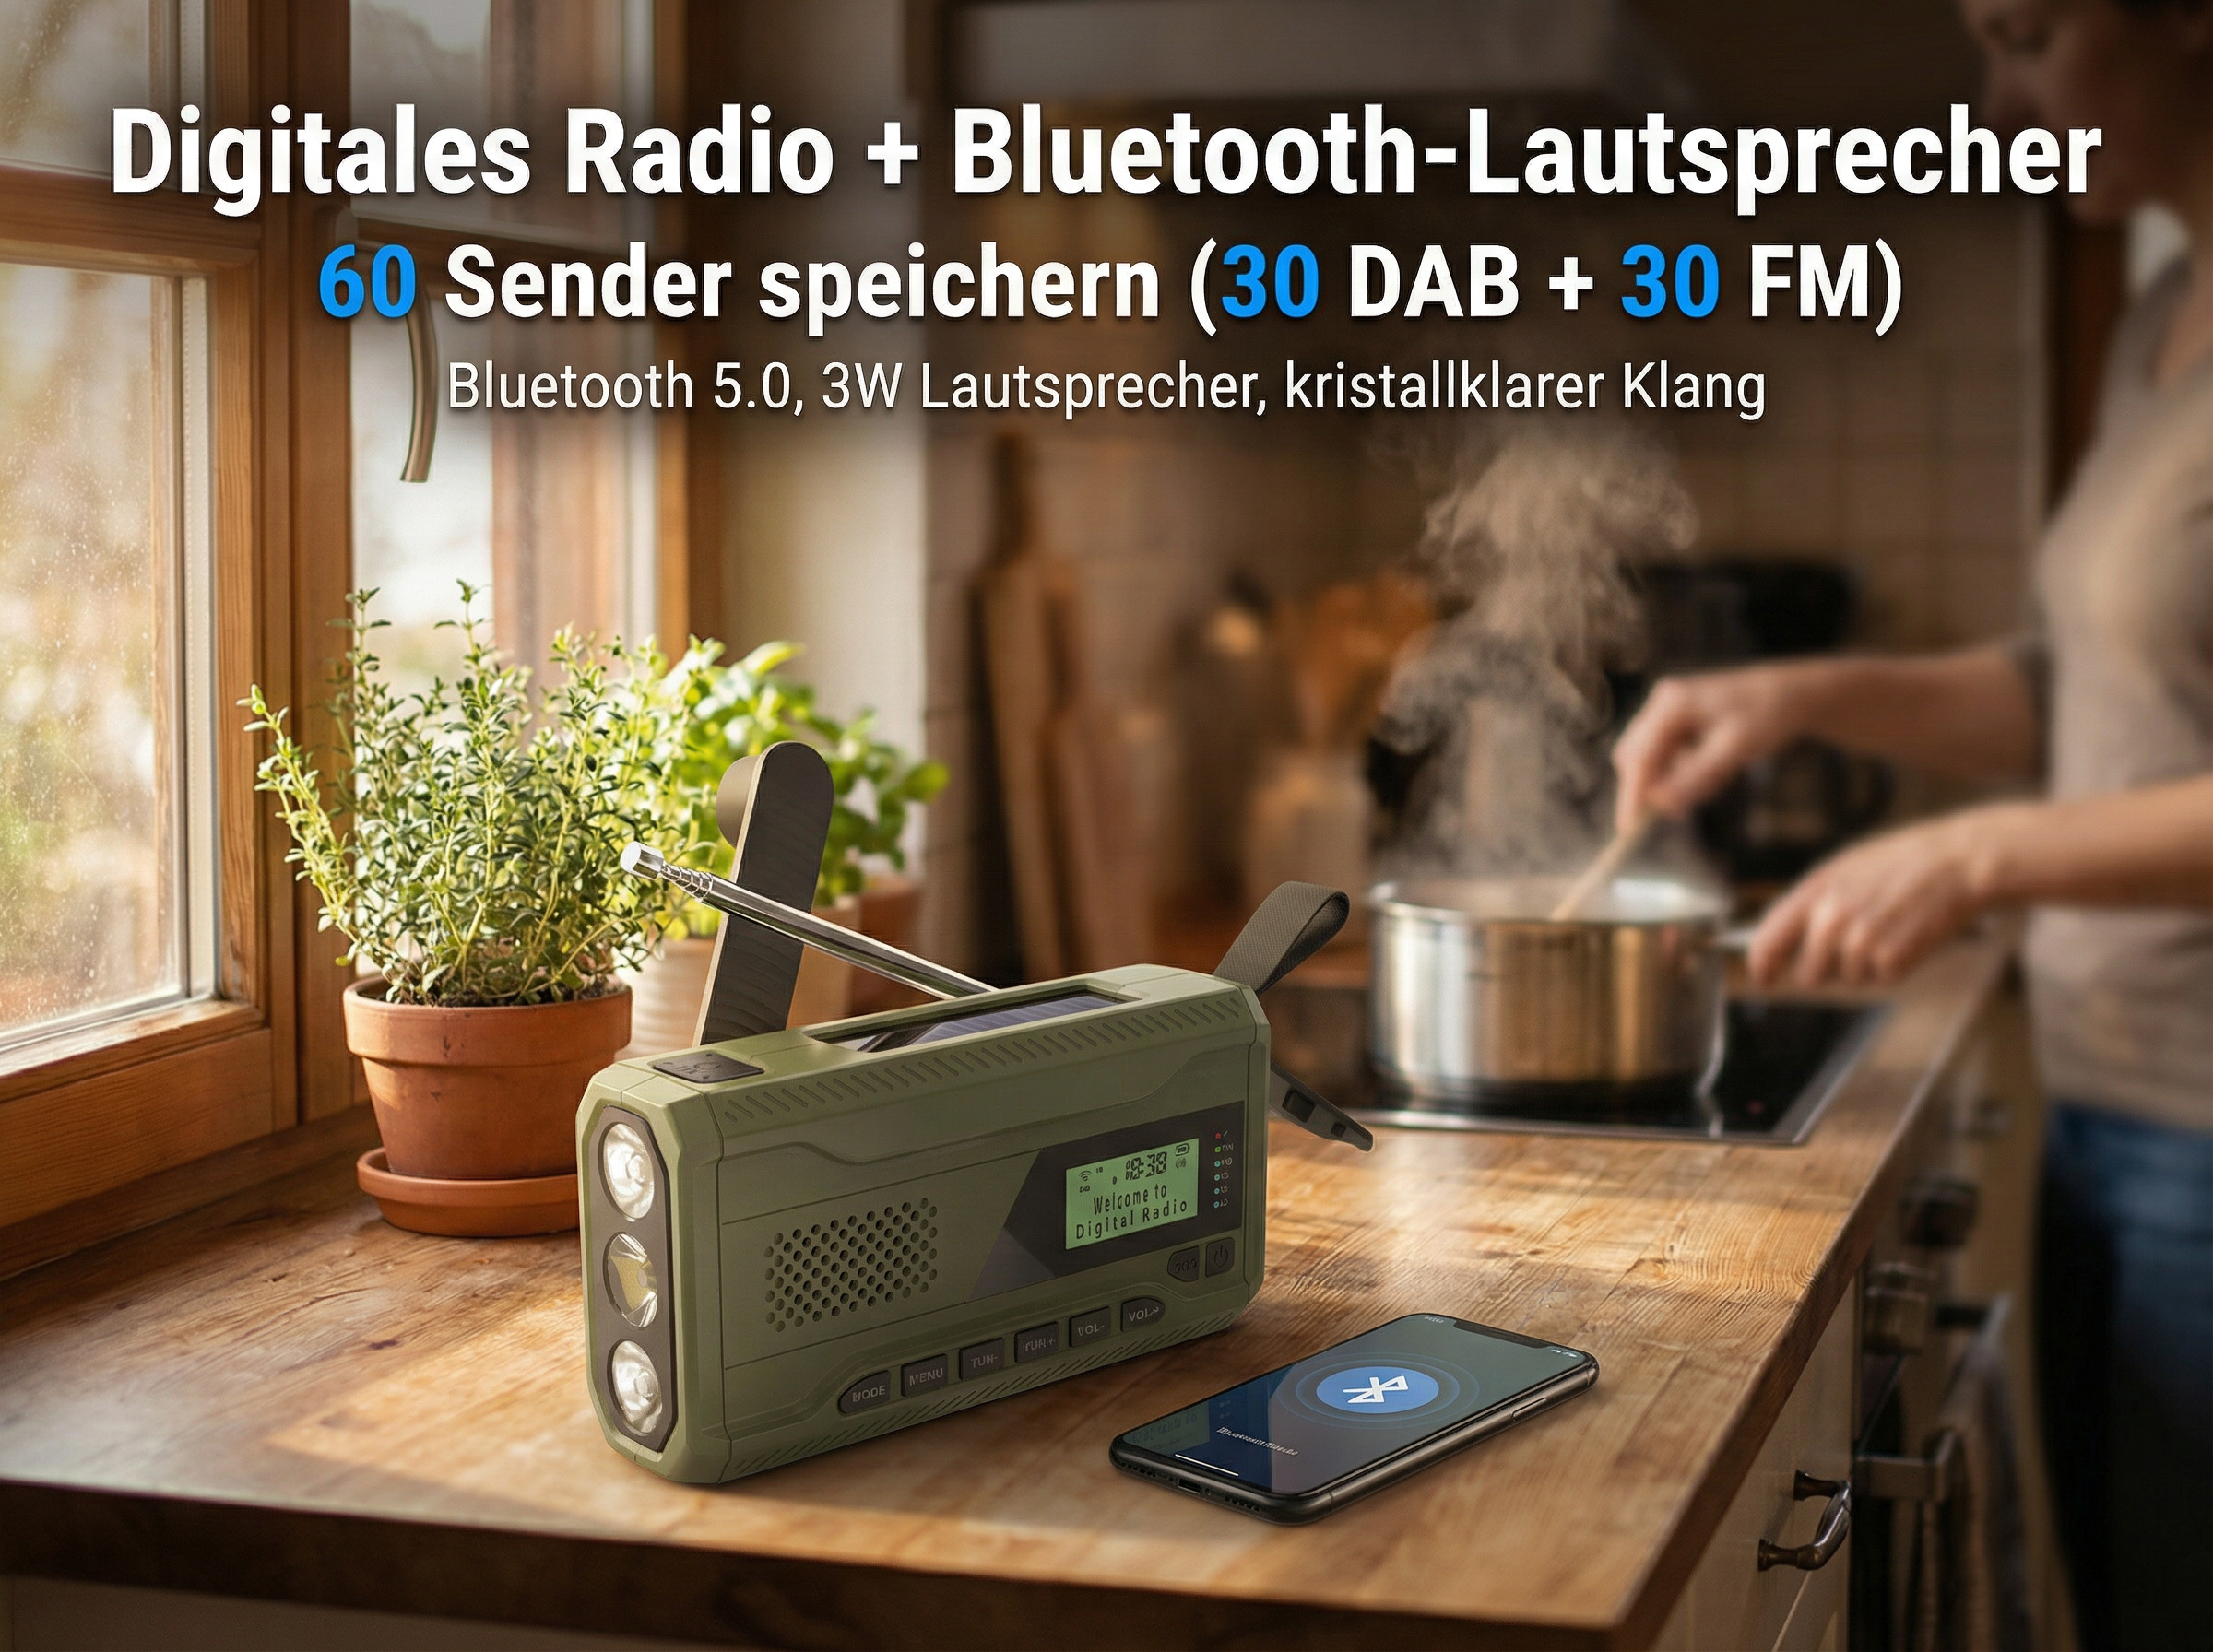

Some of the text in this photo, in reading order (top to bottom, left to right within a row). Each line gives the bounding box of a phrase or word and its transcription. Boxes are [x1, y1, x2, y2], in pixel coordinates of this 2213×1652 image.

[1093, 1183, 1166, 1215] Welcome to
[1076, 1199, 1187, 1239] Digital Radio
[909, 1367, 943, 1386] MENU
